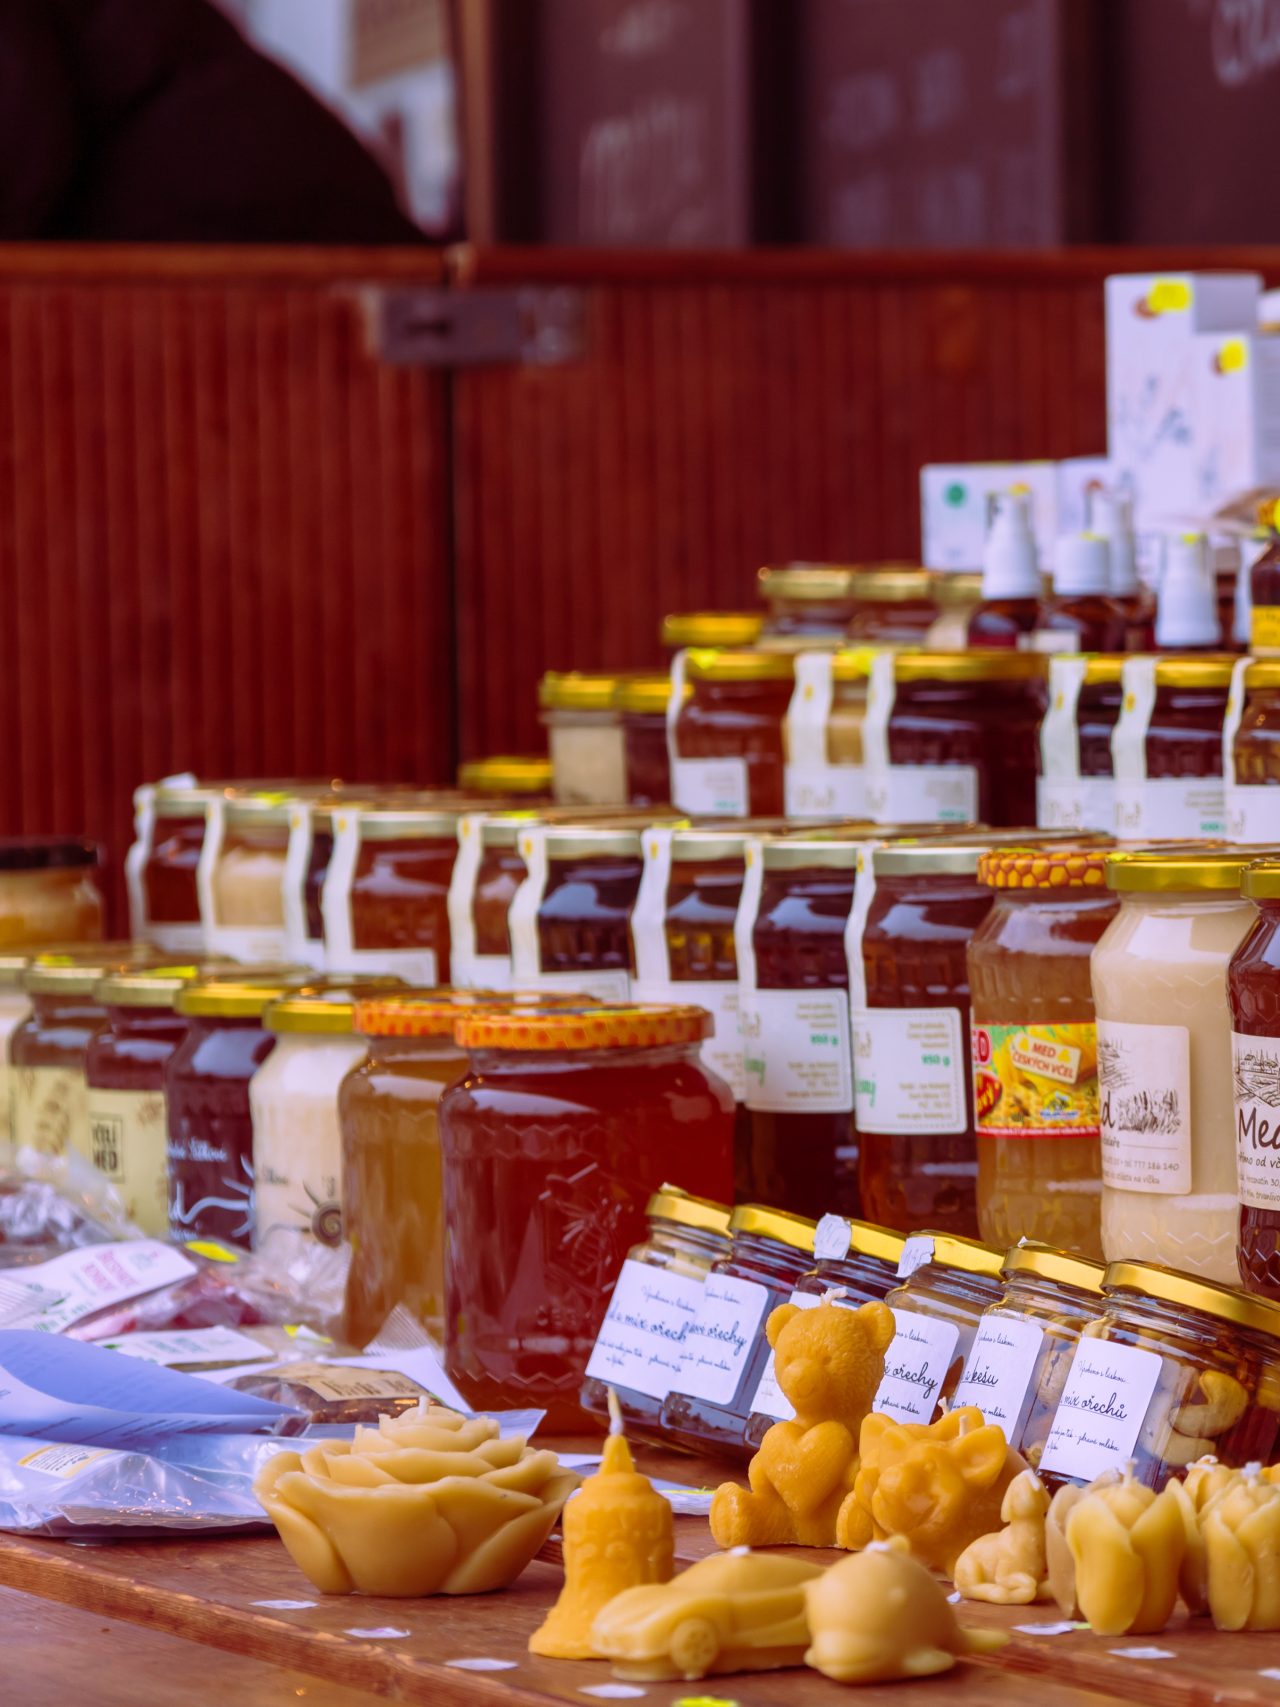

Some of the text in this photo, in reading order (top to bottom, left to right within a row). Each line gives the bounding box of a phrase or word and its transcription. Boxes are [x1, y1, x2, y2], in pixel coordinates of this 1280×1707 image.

[1012, 1050, 1074, 1079] ČESKÝCH VČEL
[1032, 1043, 1057, 1058] MED
[1162, 1162, 1180, 1172] 140
[1255, 1155, 1266, 1168] od
[625, 1312, 648, 1329] mix
[650, 1320, 687, 1343] ořech
[707, 1320, 747, 1357] ořechy
[892, 1361, 939, 1400] ořechy
[971, 1356, 999, 1386] kešu
[1081, 1391, 1128, 1420] ořechů
